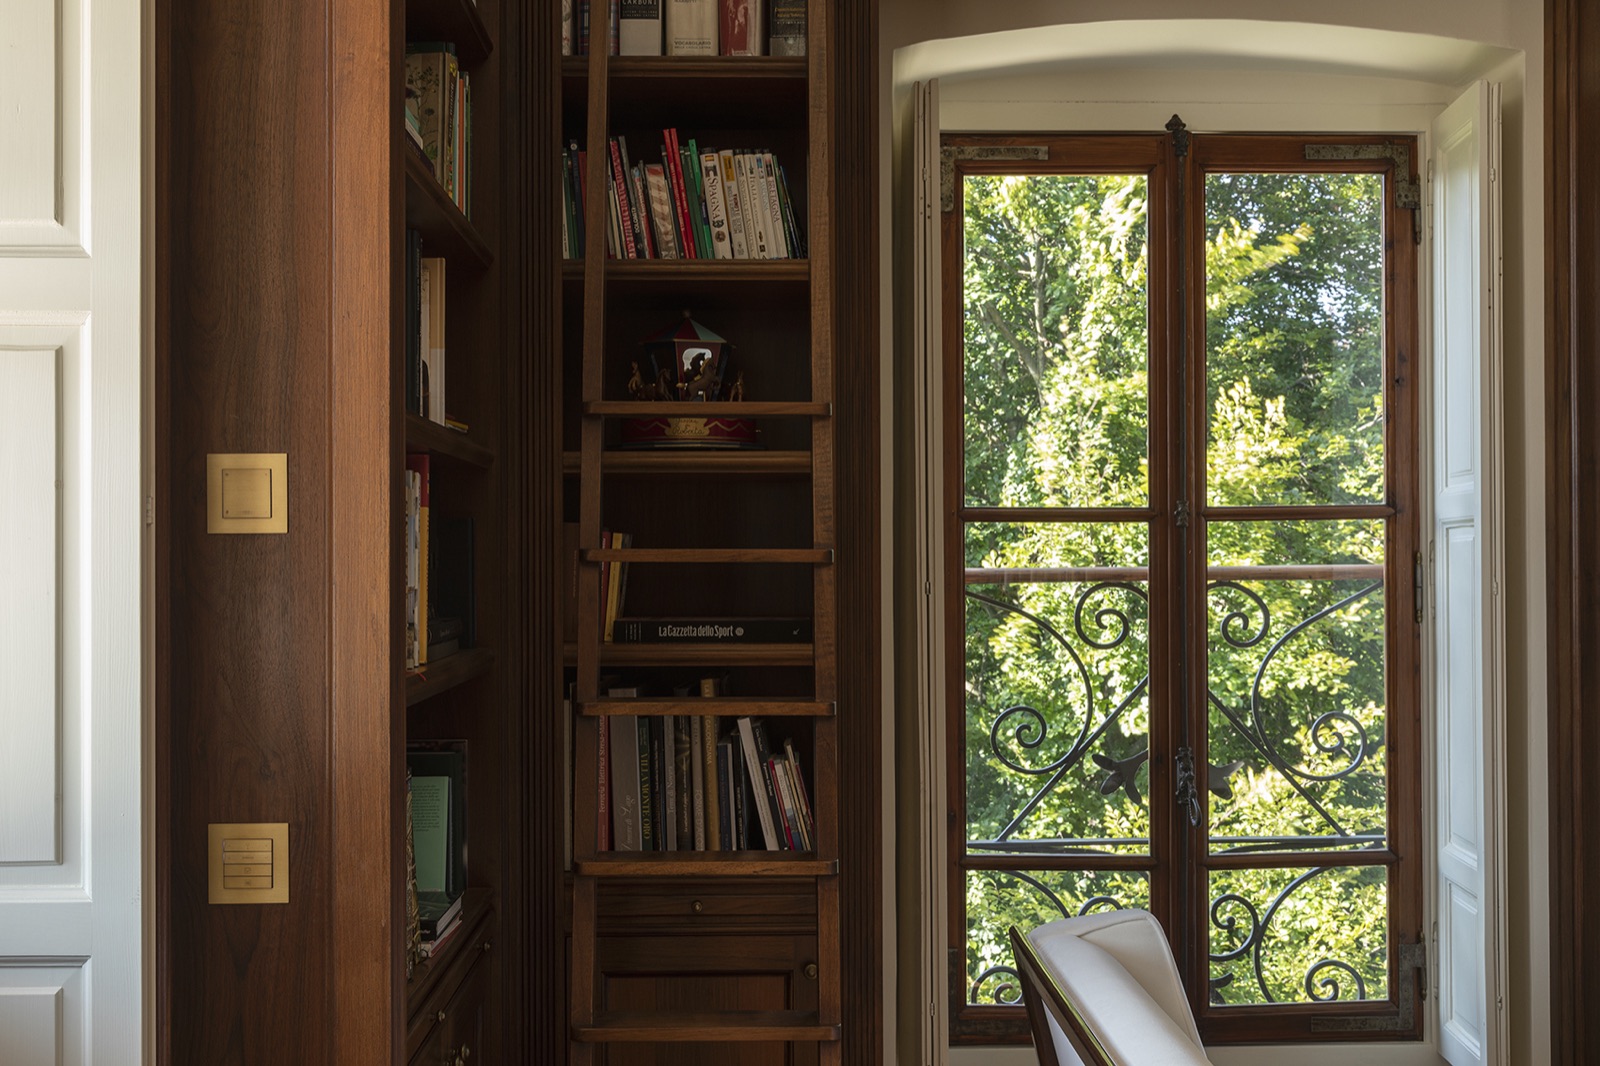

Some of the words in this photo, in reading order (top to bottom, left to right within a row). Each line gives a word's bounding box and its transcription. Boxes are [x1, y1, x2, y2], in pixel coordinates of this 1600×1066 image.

[706, 178, 721, 220] SPAGNA
[749, 176, 758, 201] ITALIA
[659, 626, 667, 637] La
[667, 625, 697, 637] Gazzetta
[697, 624, 714, 637] dello
[714, 625, 734, 638] Sport
[640, 752, 649, 782] VILLA
[641, 783, 650, 816] MONTE
[643, 818, 651, 840] ORO
